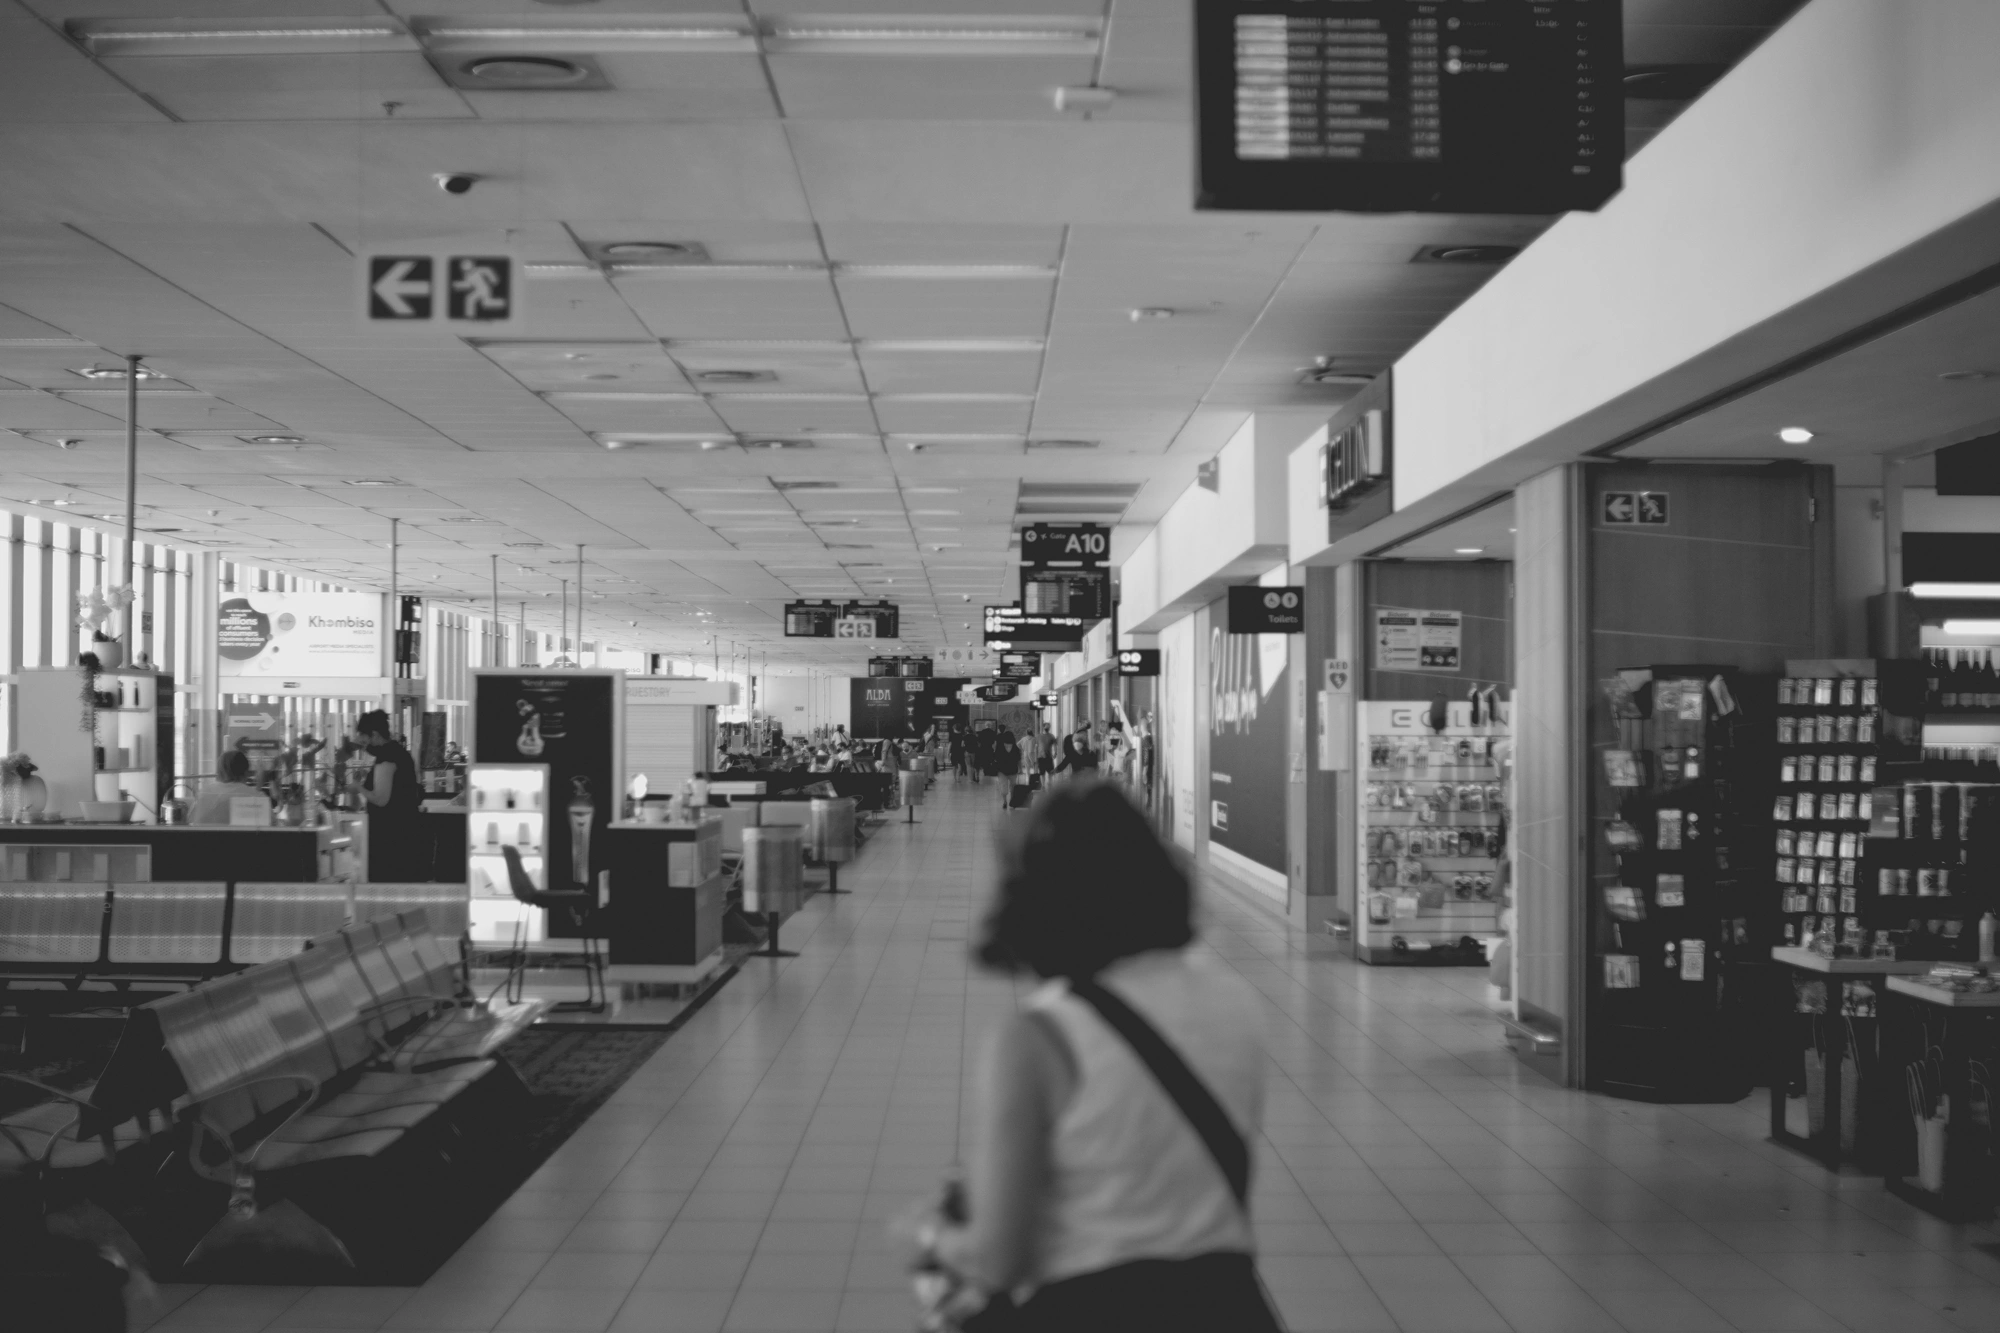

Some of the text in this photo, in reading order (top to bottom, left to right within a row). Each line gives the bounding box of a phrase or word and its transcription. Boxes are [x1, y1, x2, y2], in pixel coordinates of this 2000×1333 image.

[1050, 532, 1105, 554] Gate A10
[219, 617, 258, 626] millions
[1268, 614, 1299, 623] Toilets
[1329, 661, 1348, 670] AED
